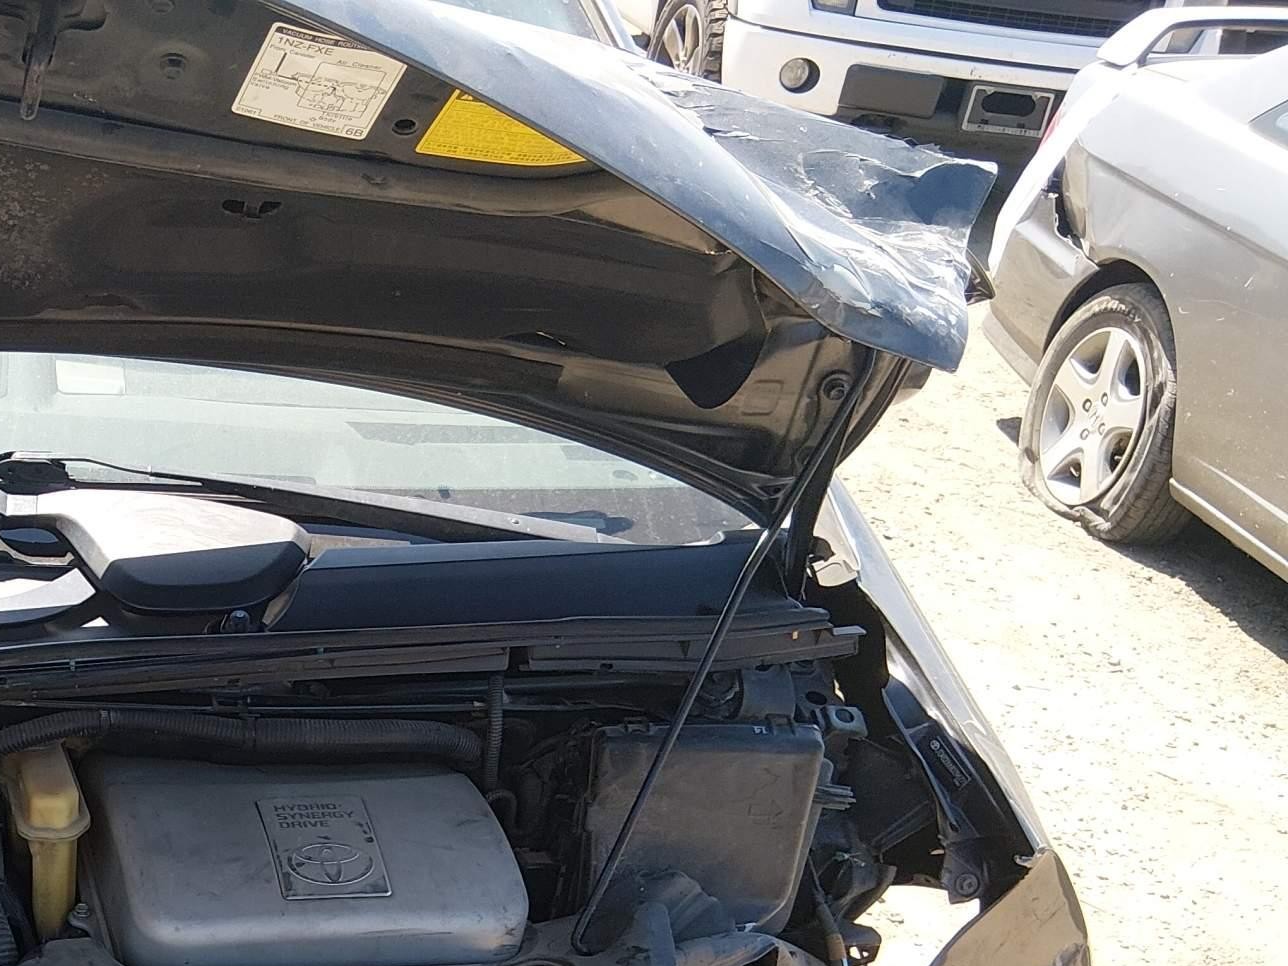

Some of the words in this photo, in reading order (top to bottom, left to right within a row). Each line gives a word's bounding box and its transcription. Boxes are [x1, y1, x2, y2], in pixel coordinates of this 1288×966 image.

[282, 28, 313, 40] VACUUM
[278, 37, 335, 56] 1NZ-FXE
[345, 127, 364, 138] 6B
[276, 811, 354, 821] SYNERGY
[278, 820, 330, 829] DRIVE
